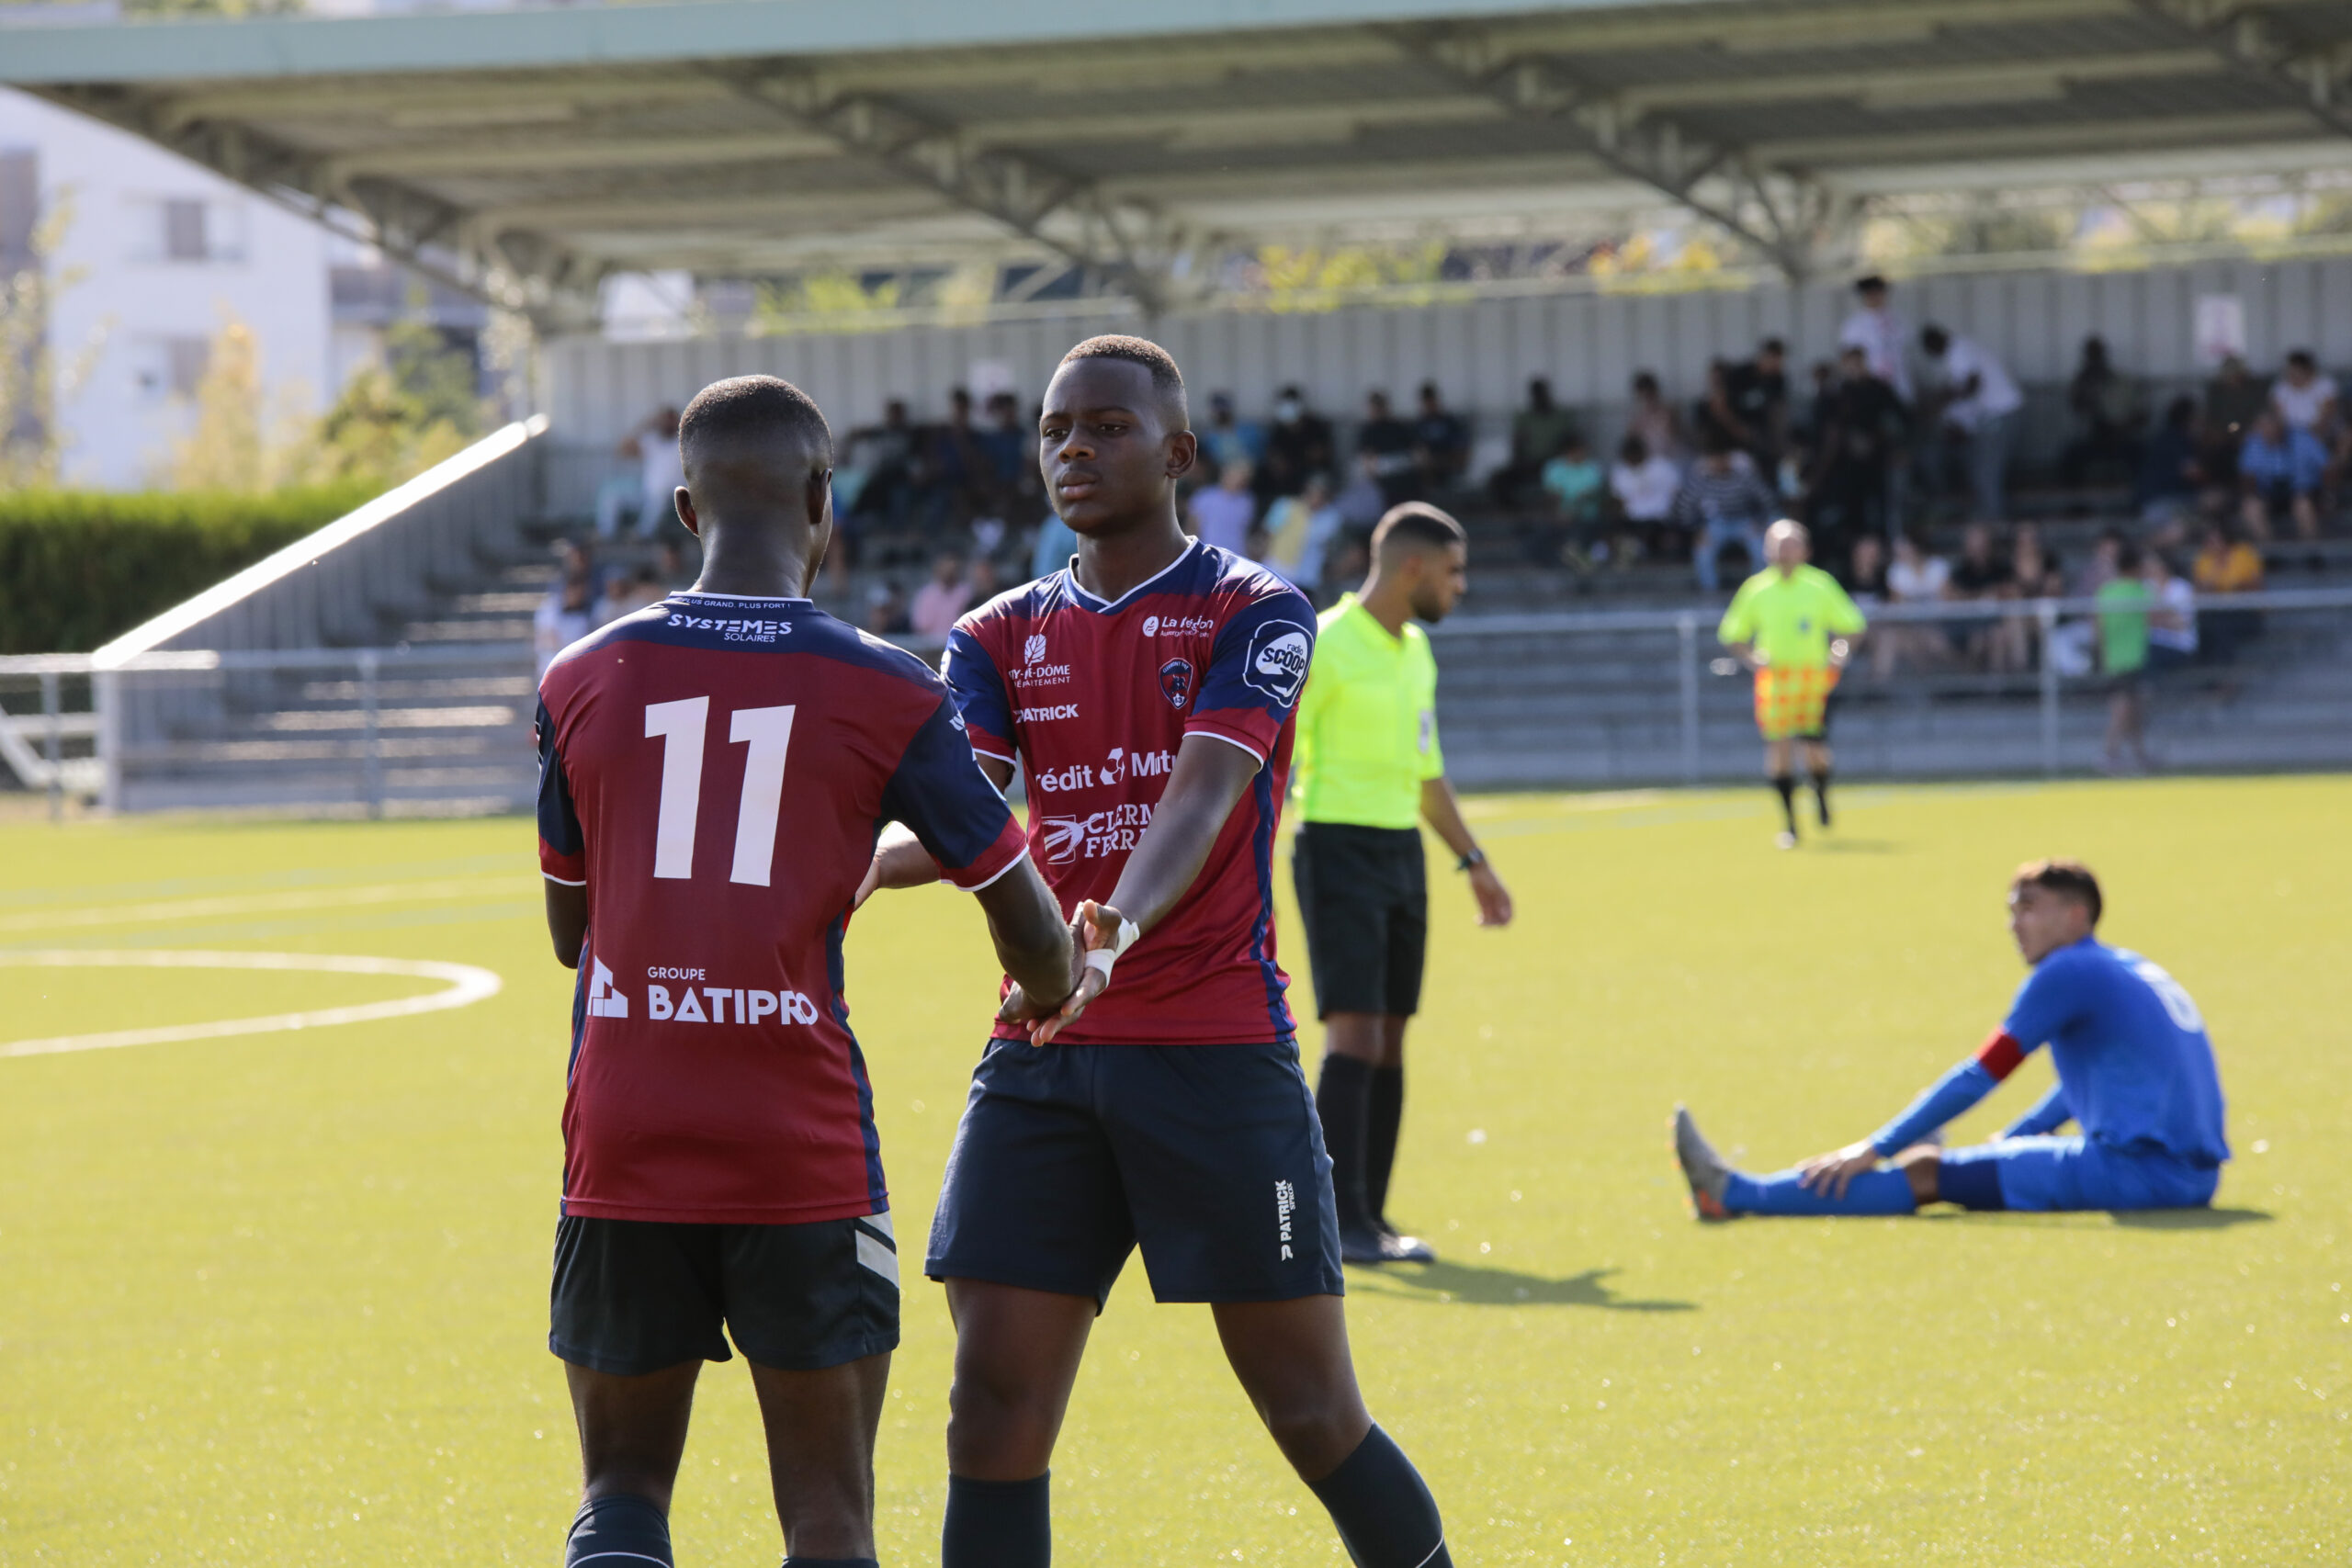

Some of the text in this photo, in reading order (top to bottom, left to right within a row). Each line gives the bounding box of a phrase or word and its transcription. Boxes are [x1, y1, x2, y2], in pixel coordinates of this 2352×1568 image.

[1162, 616, 1177, 627] La
[724, 633, 775, 643] SOLAIRES
[1287, 644, 1303, 655] radio
[1262, 648, 1305, 673] SCOOP
[1014, 704, 1079, 723] ATRICK
[1035, 750, 1177, 793] rédit Mut
[645, 695, 797, 887] 11
[1088, 803, 1159, 834] CLERM
[1084, 829, 1148, 858] FERR
[648, 966, 706, 980] GROUPE
[648, 984, 819, 1026] BATIPRO
[1275, 1179, 1292, 1242] PATRICK
